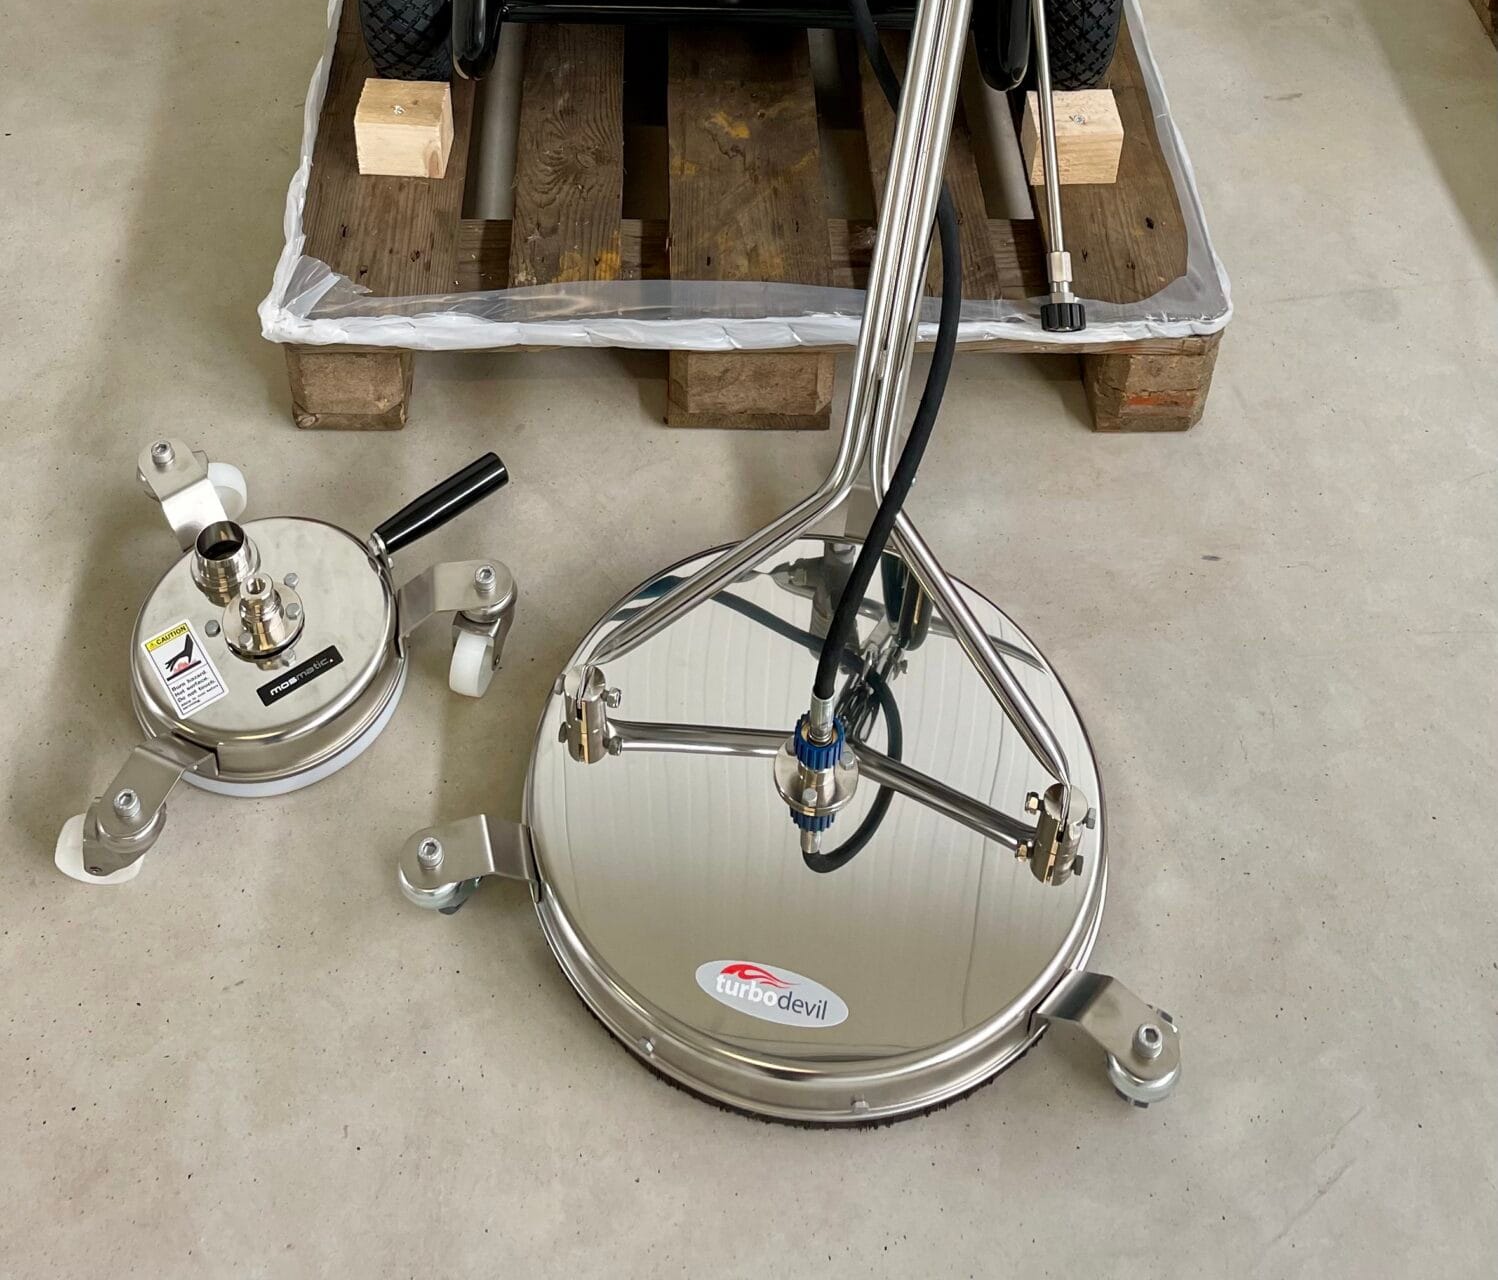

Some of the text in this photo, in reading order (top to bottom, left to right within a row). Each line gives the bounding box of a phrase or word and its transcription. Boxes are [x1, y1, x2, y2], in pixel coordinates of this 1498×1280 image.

[155, 625, 187, 645] CAUTION
[174, 689, 186, 698] Hot
[187, 689, 197, 698] not
[715, 973, 828, 1021] turbodevil
